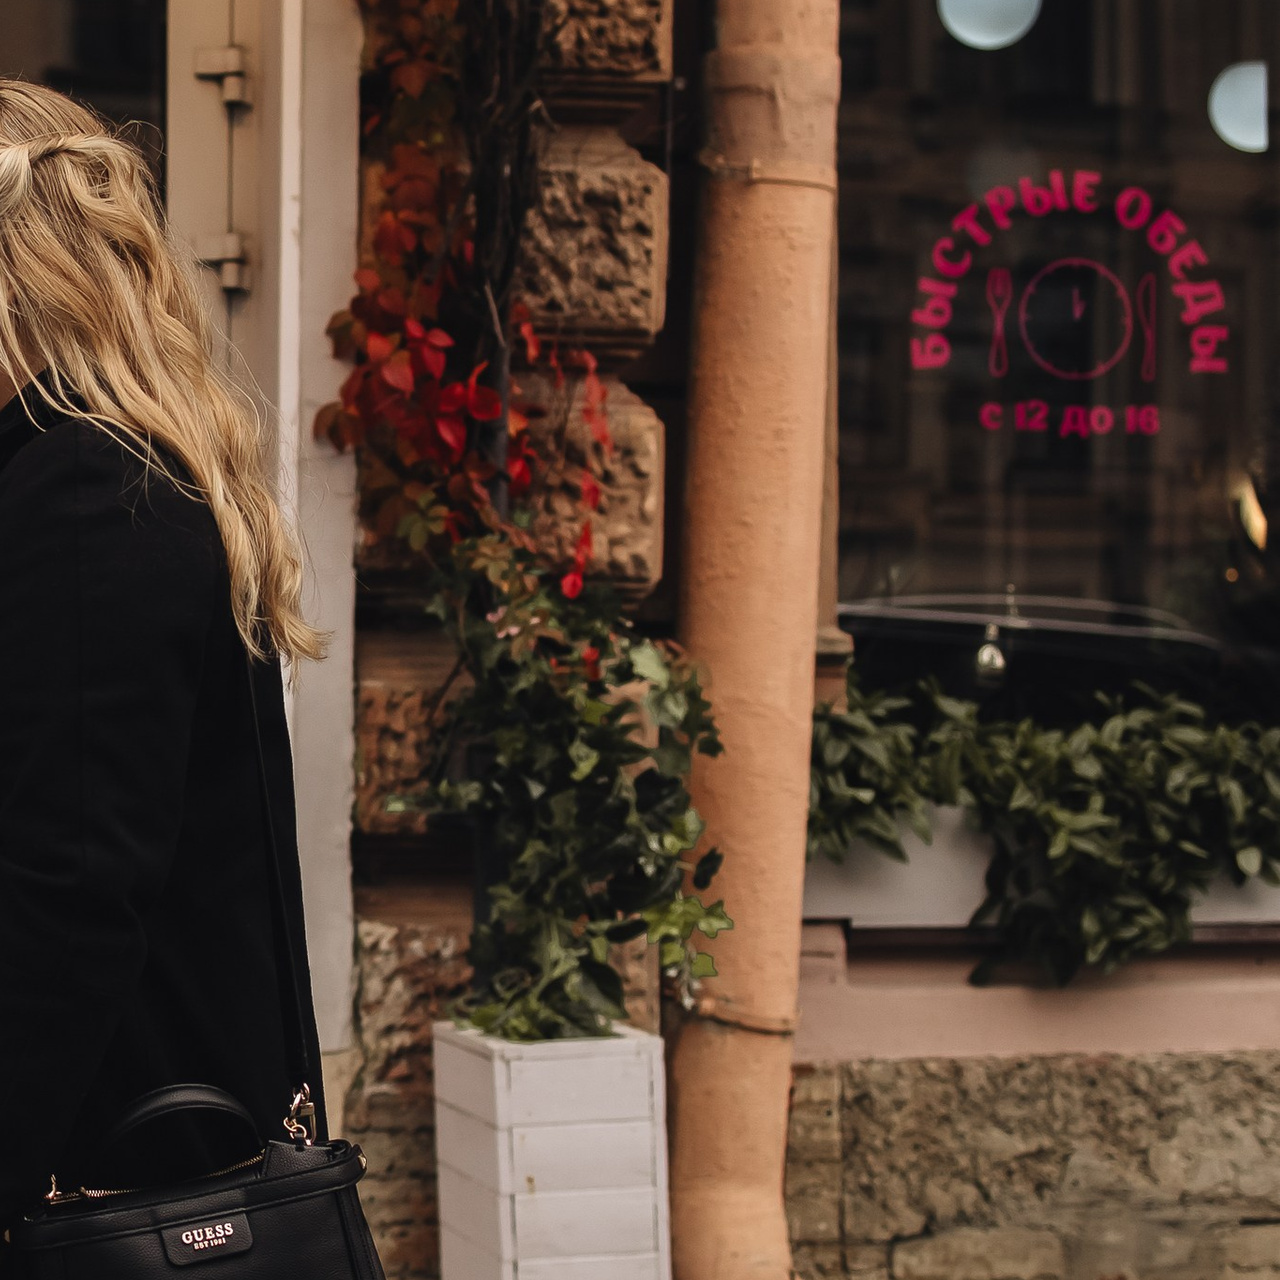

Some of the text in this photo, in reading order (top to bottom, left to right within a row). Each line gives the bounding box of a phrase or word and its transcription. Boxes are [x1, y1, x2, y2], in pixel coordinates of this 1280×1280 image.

[910, 168, 1230, 374] БЫСТРЫЕ ОБЕДЫ
[1013, 398, 1050, 432] 12
[181, 1222, 234, 1245] GUESS
